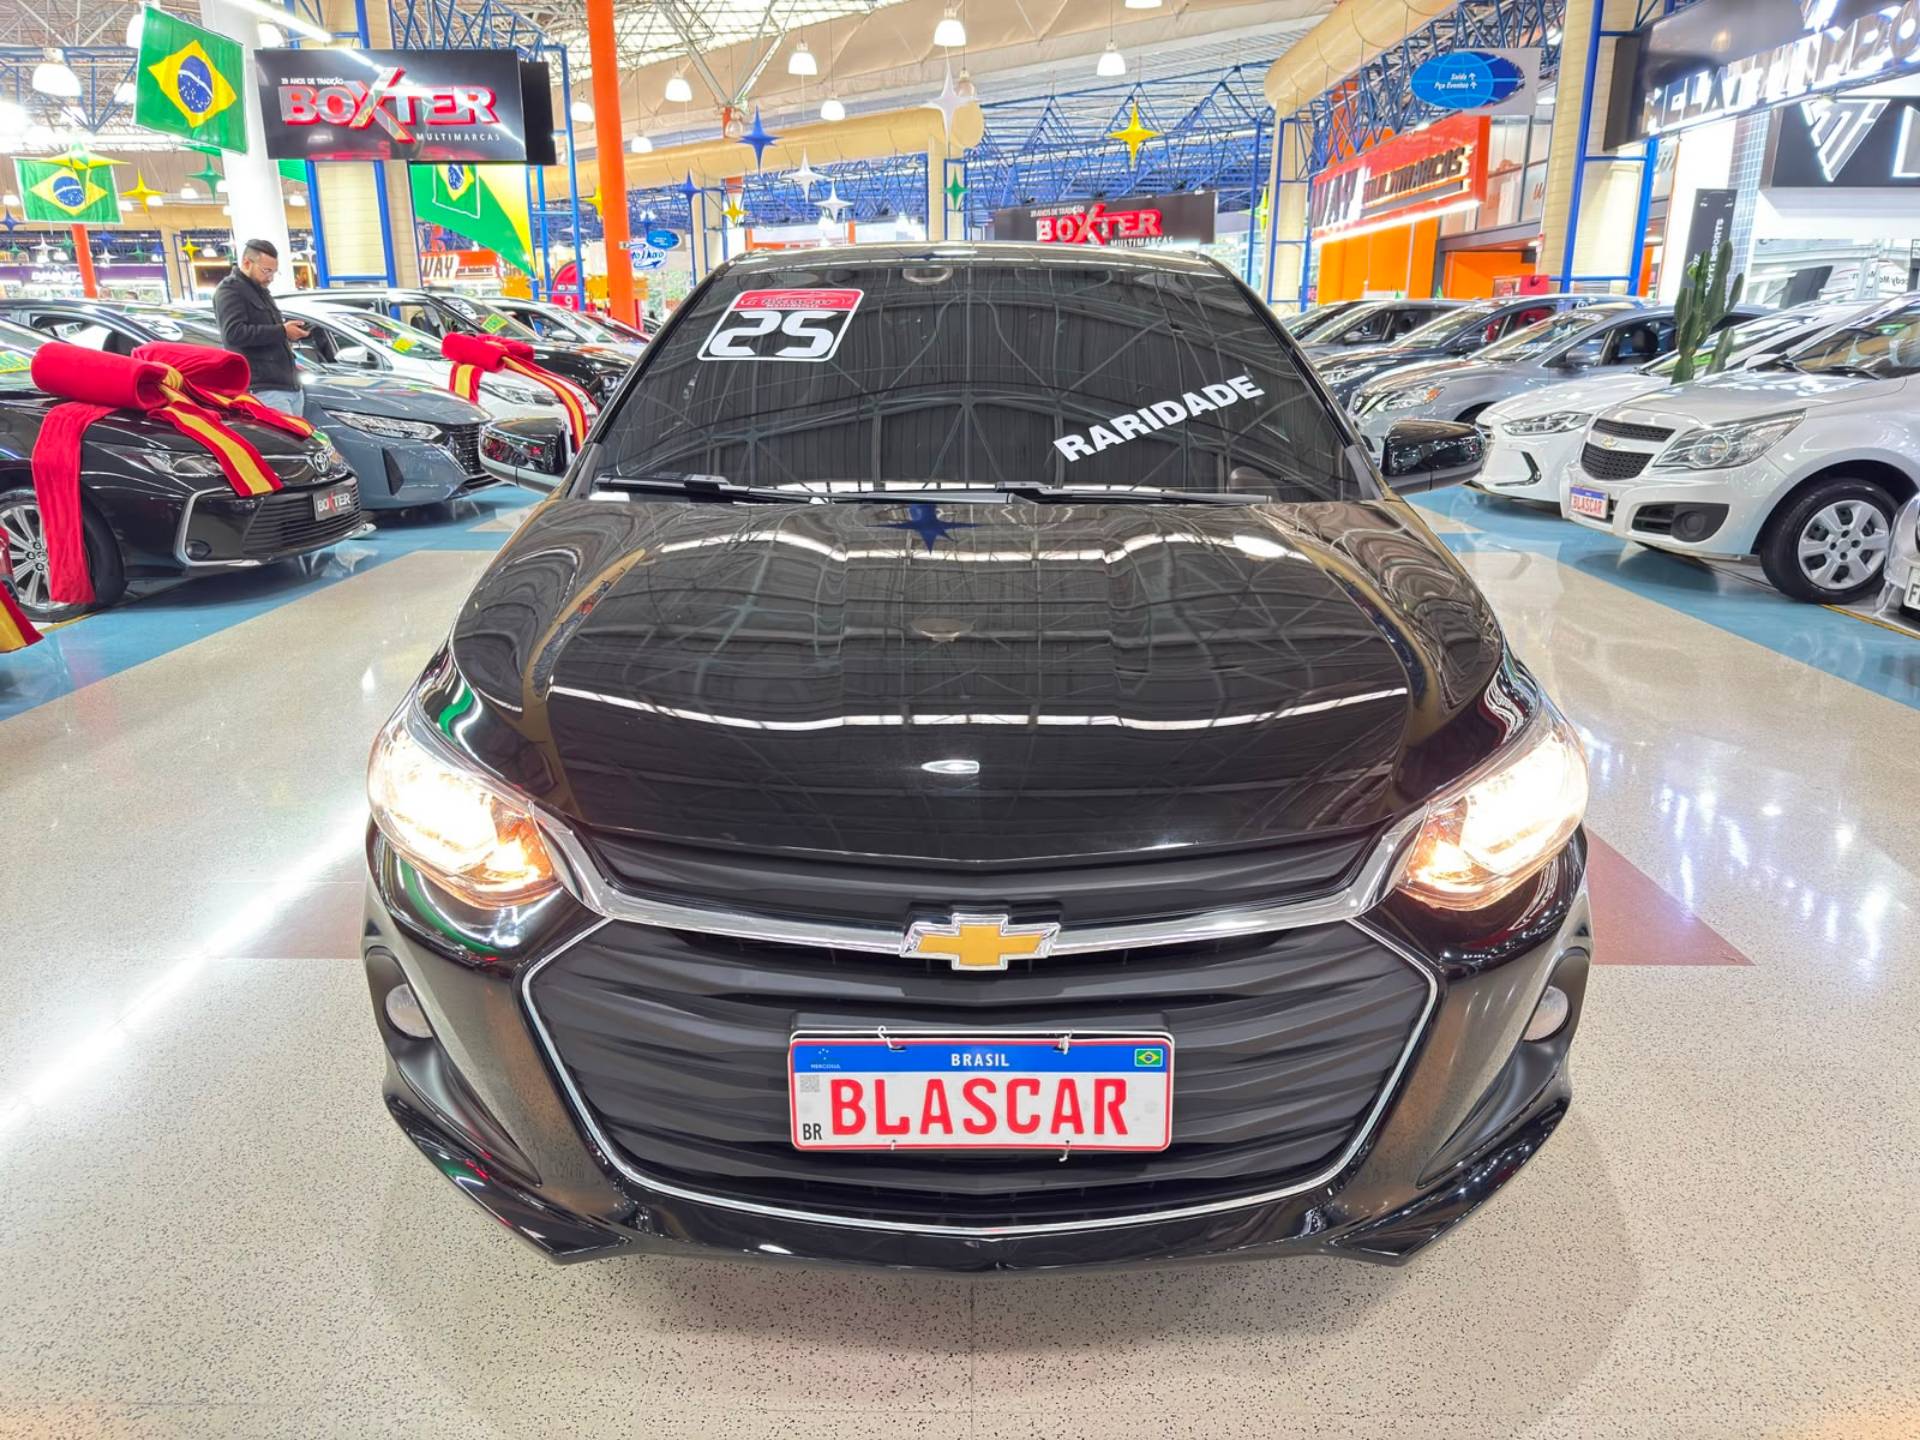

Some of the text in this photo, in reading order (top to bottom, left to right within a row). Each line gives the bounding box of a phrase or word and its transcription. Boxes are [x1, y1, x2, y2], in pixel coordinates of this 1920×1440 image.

[306, 77, 316, 85] DE
[278, 66, 500, 144] BOXTER
[416, 132, 501, 141] MULTIMARCAS
[1036, 203, 1164, 245] BOXTER
[1110, 236, 1175, 248] MULTIMARCAS
[709, 310, 838, 357] 25
[1053, 375, 1265, 462] RARIDADE
[317, 490, 351, 512] BOXTER
[951, 1053, 1010, 1067] BRASIL
[830, 1078, 1128, 1136] BLASCAR
[803, 1123, 822, 1141] BR
